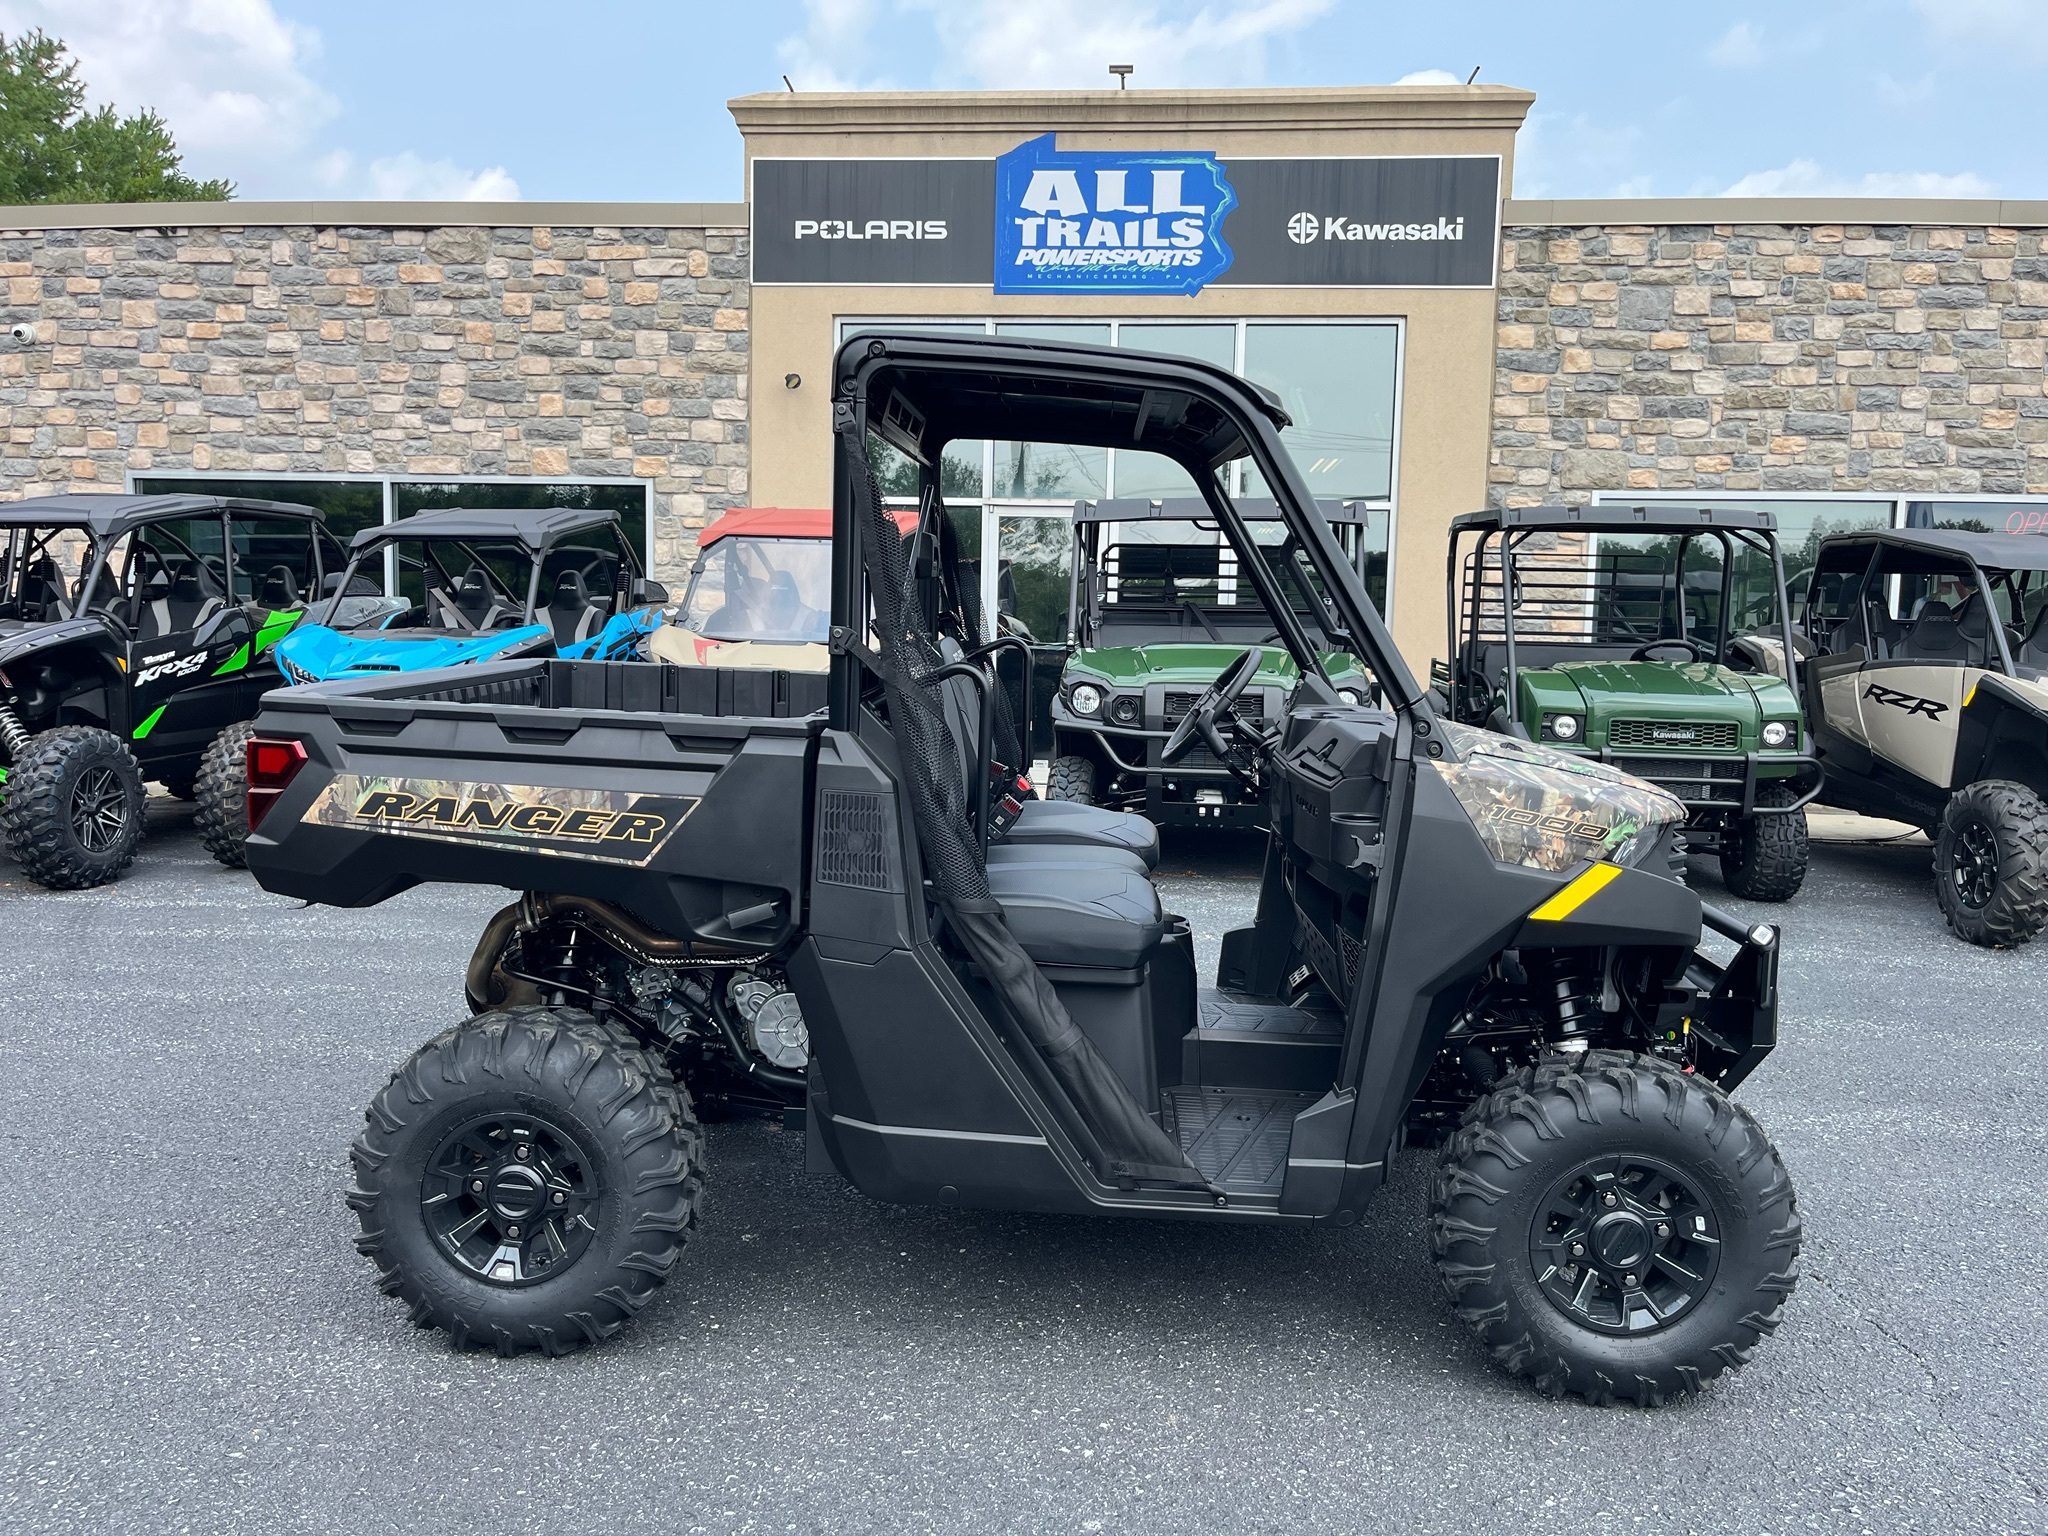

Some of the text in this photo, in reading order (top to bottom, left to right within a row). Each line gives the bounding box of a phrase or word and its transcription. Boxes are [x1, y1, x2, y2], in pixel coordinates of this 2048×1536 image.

[1020, 170, 1205, 217] ALL
[795, 220, 948, 240] POLARIS
[1015, 217, 1204, 248] TRAILS
[1324, 217, 1464, 240] Kawasaki
[1015, 249, 1203, 267] POWERSPORTS
[134, 651, 208, 687] KRX4
[177, 664, 201, 677] 1000
[1862, 684, 1949, 722] RZR
[1652, 731, 1695, 739] Kawasaki
[355, 791, 666, 843] RANGER
[1895, 791, 1937, 817] POLARIS
[1490, 804, 1610, 841] 1000
